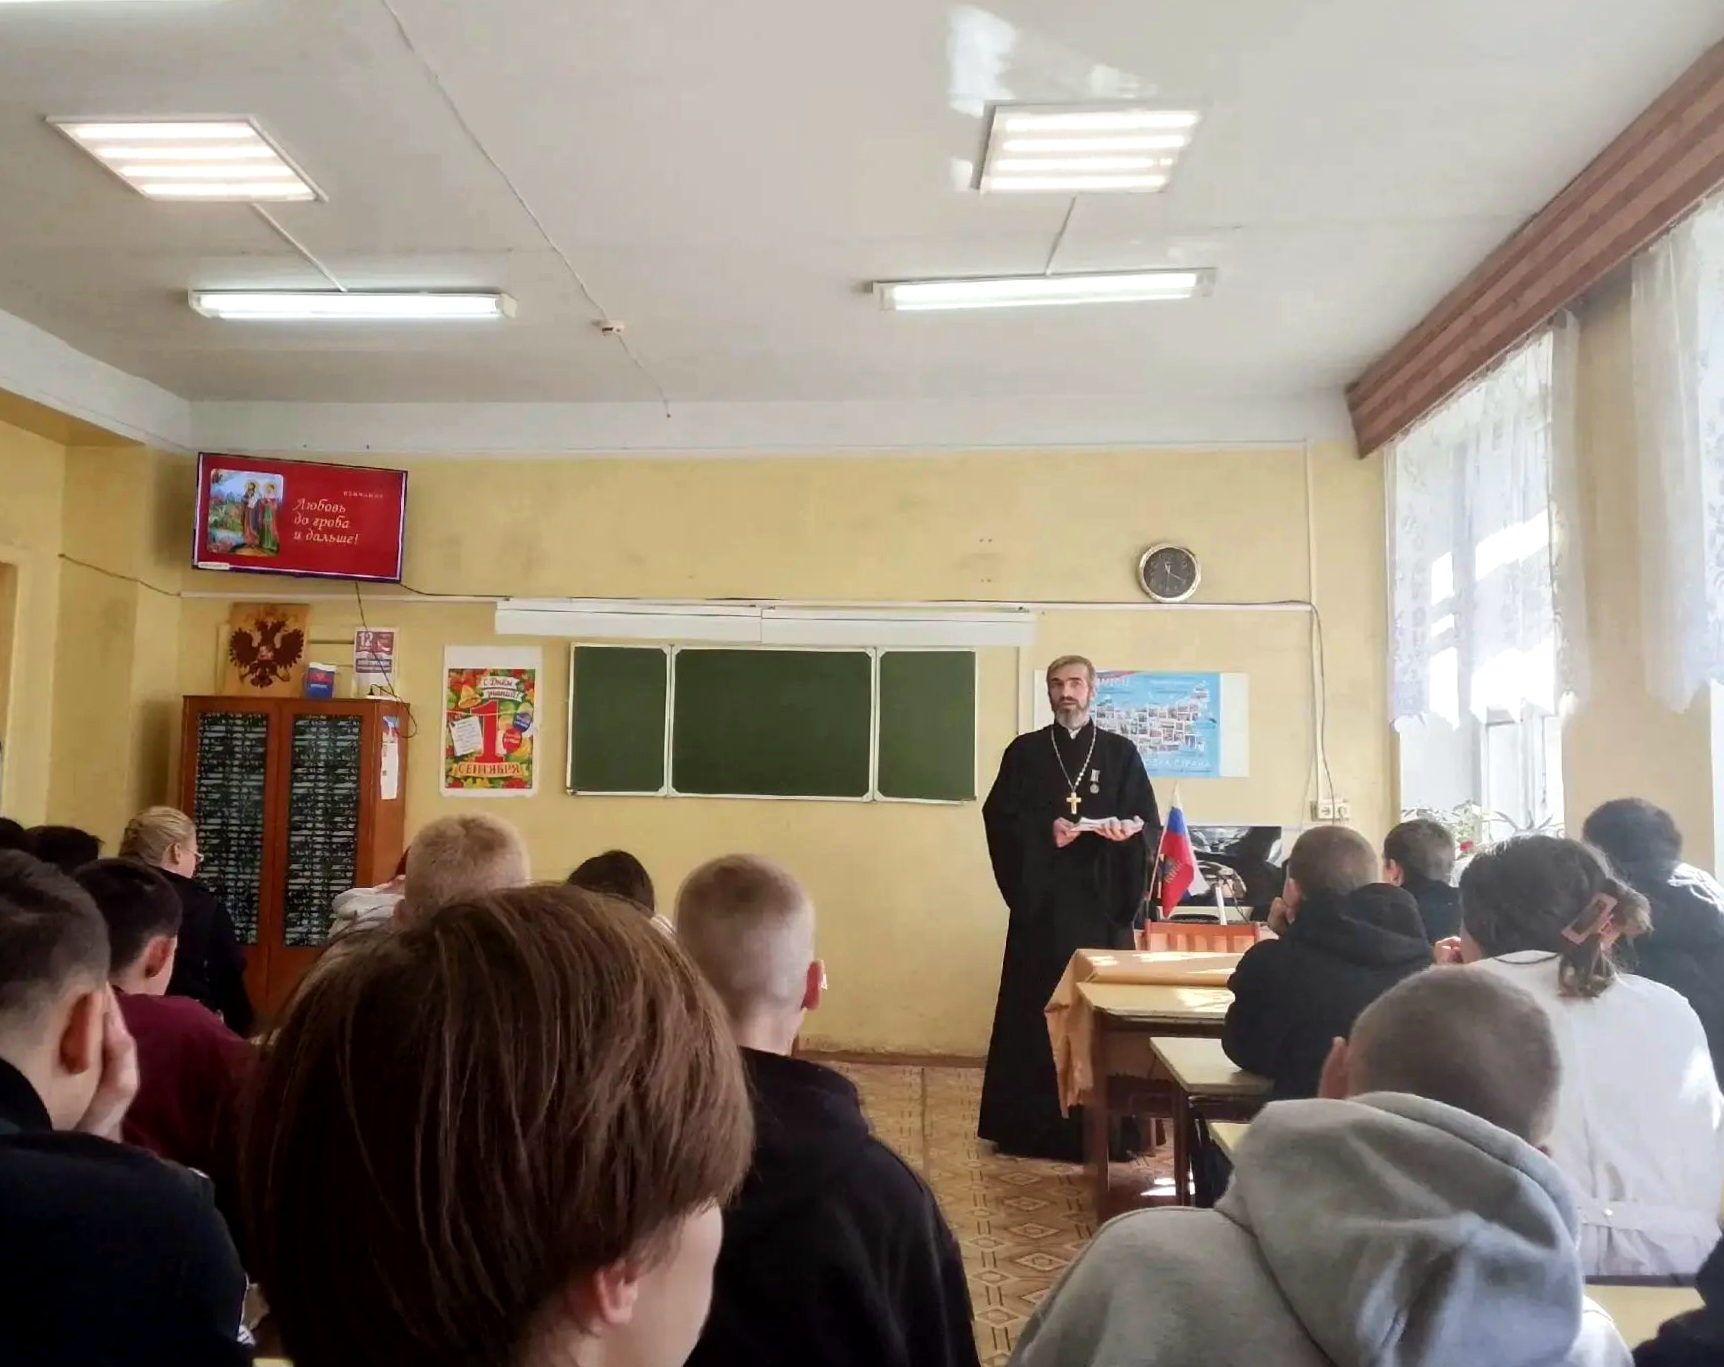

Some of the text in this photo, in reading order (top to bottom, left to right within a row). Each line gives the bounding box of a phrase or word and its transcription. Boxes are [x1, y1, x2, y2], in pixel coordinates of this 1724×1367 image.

[292, 498, 346, 513] Любовь
[294, 511, 350, 531] до гроба
[294, 527, 359, 545] и дальше!
[359, 631, 374, 647] 12
[470, 699, 505, 764] 1
[458, 763, 520, 775] СЕНТЯБРЯ
